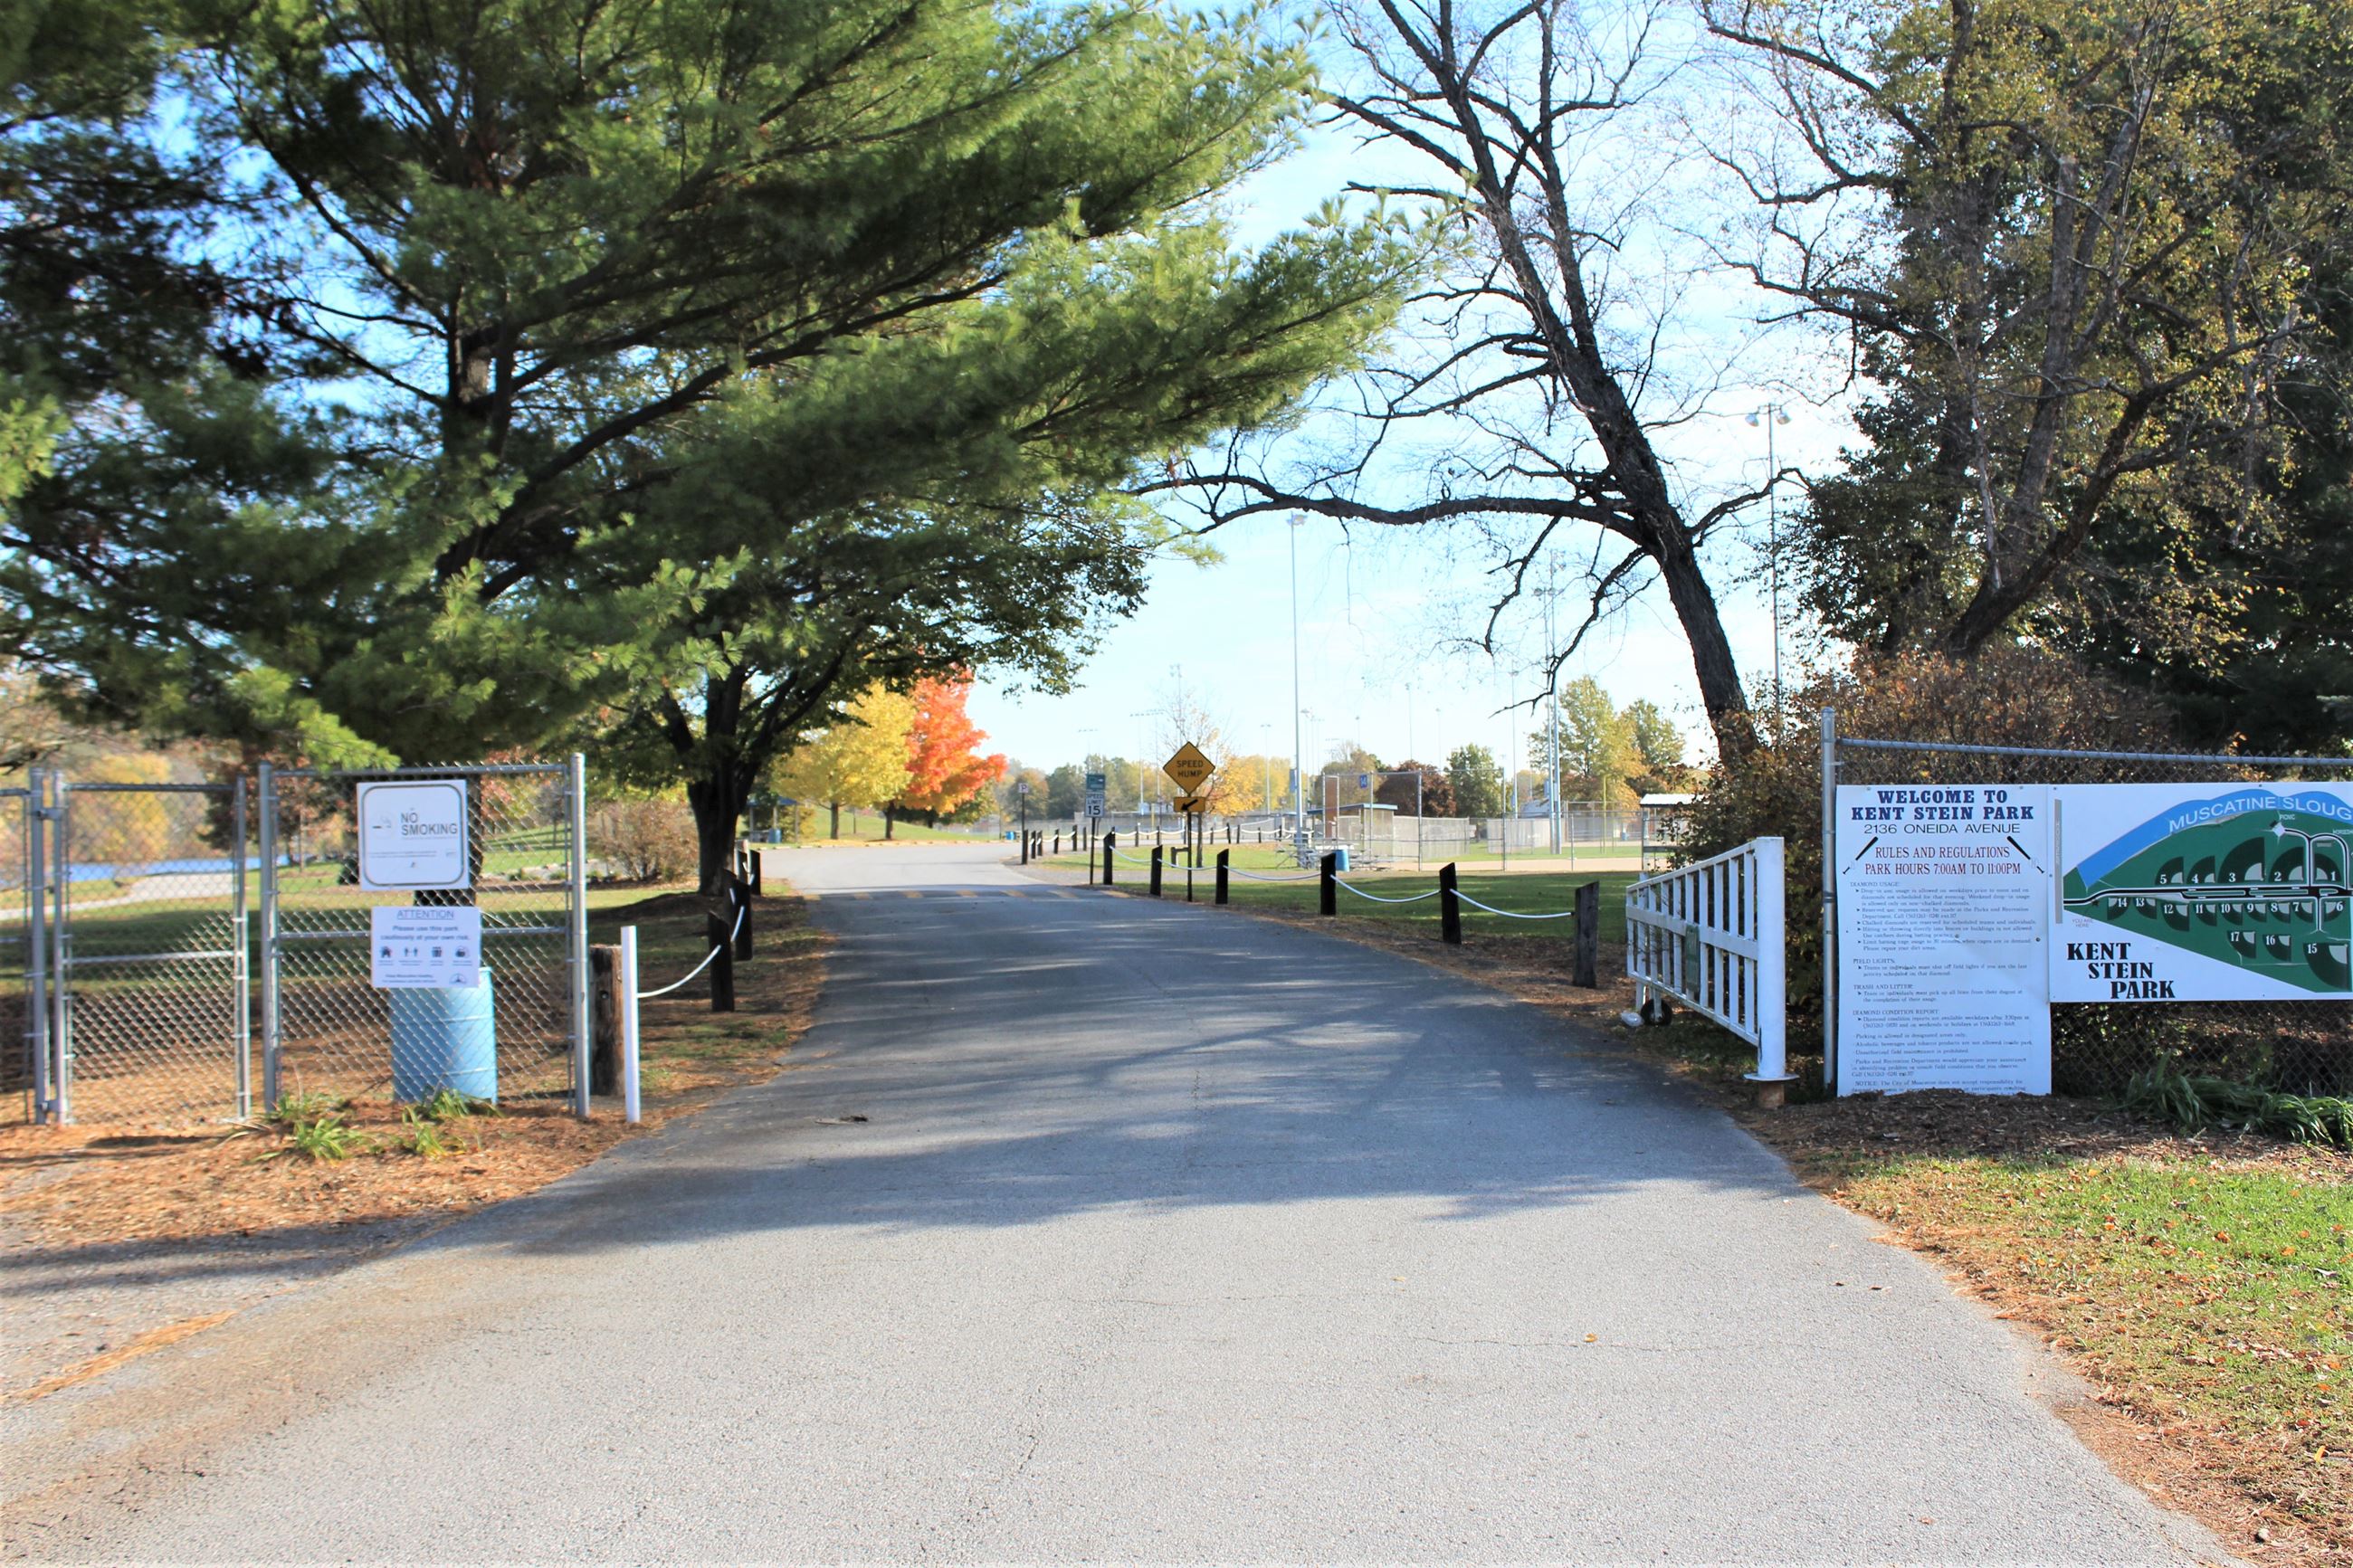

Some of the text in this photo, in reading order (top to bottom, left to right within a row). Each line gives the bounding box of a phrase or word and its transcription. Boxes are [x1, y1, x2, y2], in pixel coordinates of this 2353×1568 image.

[1176, 760, 1204, 768] SPEED
[1177, 769, 1203, 777] HUMP
[1877, 790, 2008, 804] WELCOME TO
[1088, 805, 1100, 815] 15
[1852, 805, 2034, 821] KENT STEIN PARK
[2168, 796, 2276, 833] MUSCATINE
[400, 813, 418, 823] NO
[401, 822, 458, 836] SMOKING
[1863, 823, 2020, 834] 2136 ONEIDA AVENUE
[1875, 846, 2010, 859] RULES AND REGULATIONS
[1865, 863, 2021, 875] PARK HOURS 7:00AM TO 11:00PM
[2159, 874, 2167, 884] 5
[2191, 873, 2199, 884] 4
[2228, 872, 2236, 883] 3
[2273, 872, 2282, 882] 2
[2329, 871, 2337, 881] 1
[2117, 897, 2128, 908] 14
[2135, 897, 2145, 908] 13
[2246, 903, 2254, 913] 9
[2270, 902, 2279, 913] 8
[2292, 902, 2300, 912] 7
[2336, 901, 2344, 911] 6
[397, 909, 454, 919] ATTENTION
[2163, 904, 2174, 914] 12
[2195, 904, 2204, 914] 11
[2220, 903, 2231, 914] 10
[2230, 931, 2240, 942] 17
[2265, 935, 2276, 946] 16
[2067, 942, 2131, 961] KENT
[2306, 943, 2318, 954] 15
[2088, 962, 2154, 980] STEIN
[2110, 980, 2176, 999] PARK
